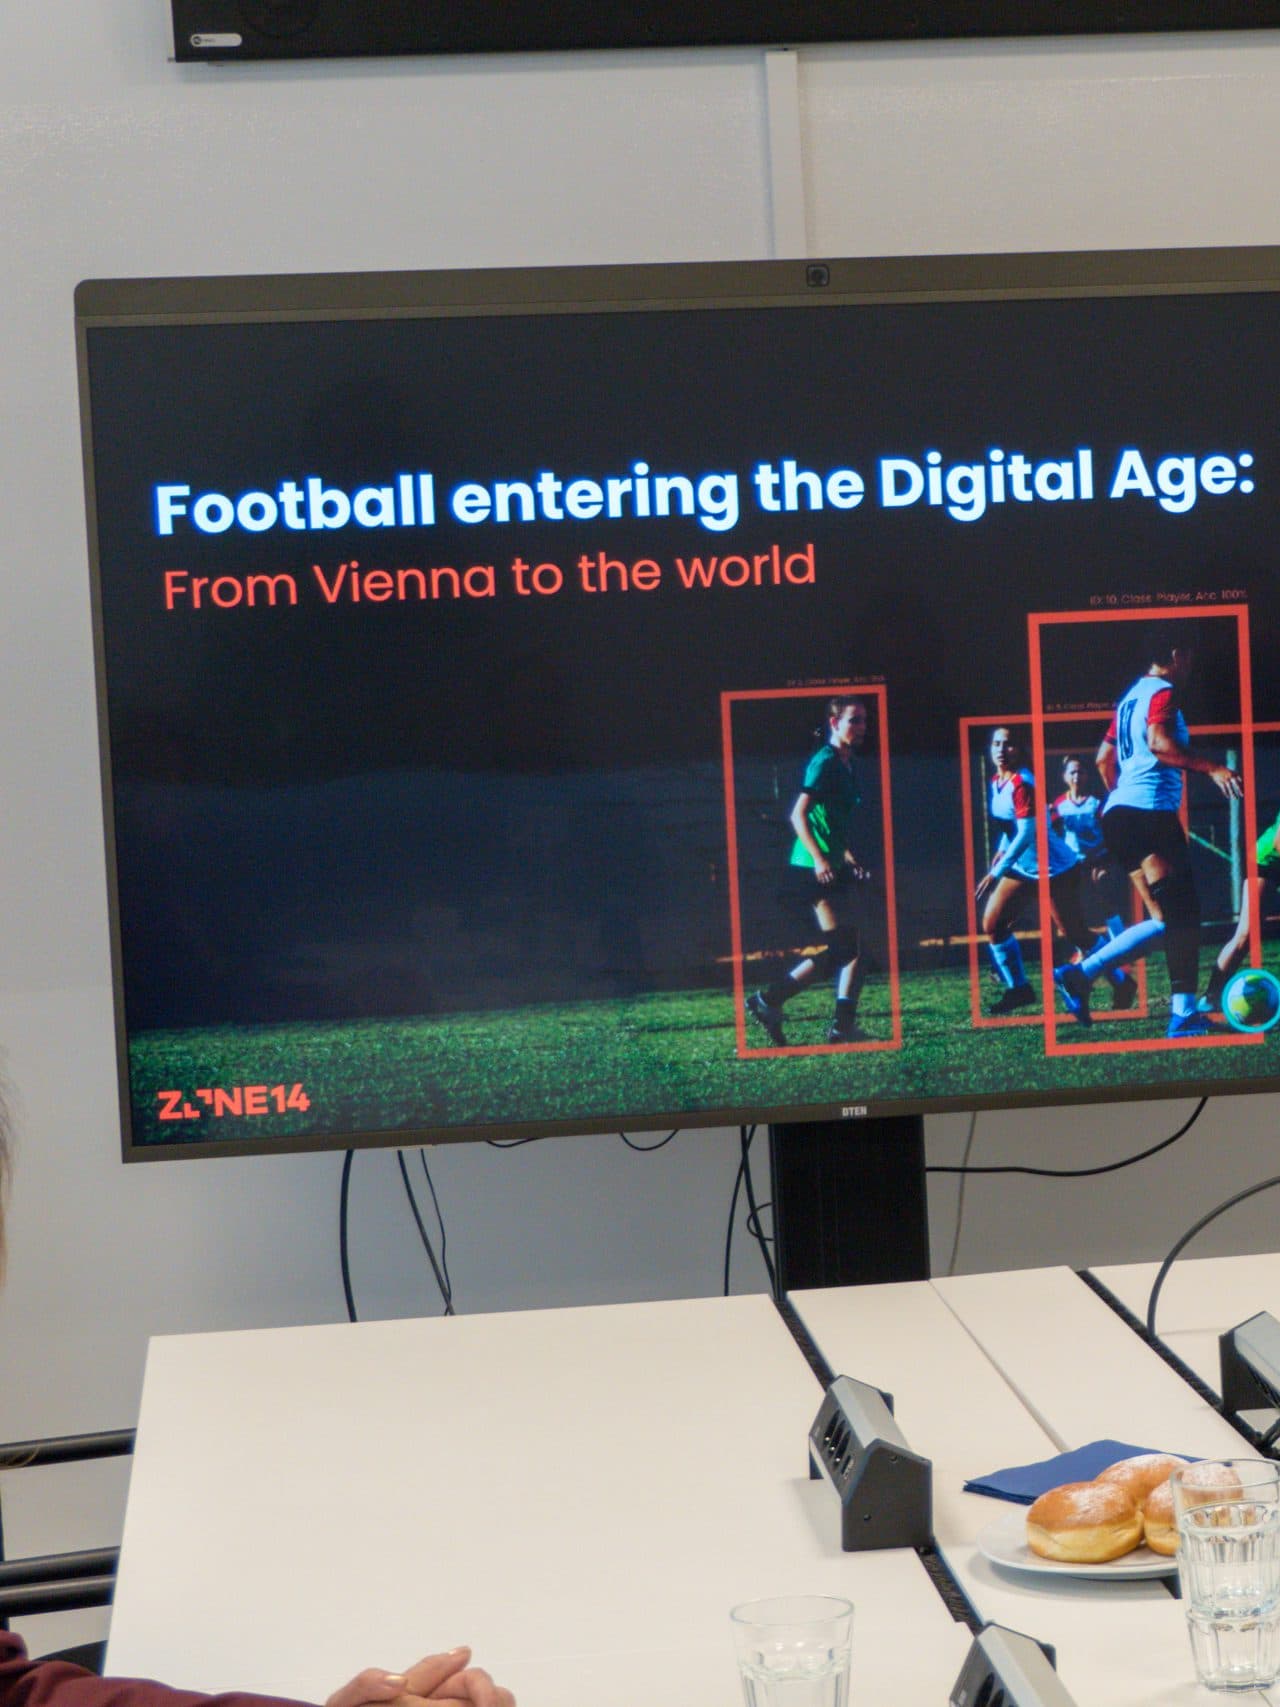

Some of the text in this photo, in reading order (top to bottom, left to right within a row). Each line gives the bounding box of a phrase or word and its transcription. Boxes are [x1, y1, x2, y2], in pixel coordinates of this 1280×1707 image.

[155, 449, 1254, 535] Football entering the Digital Age:
[164, 543, 816, 610] From Vienna to the world
